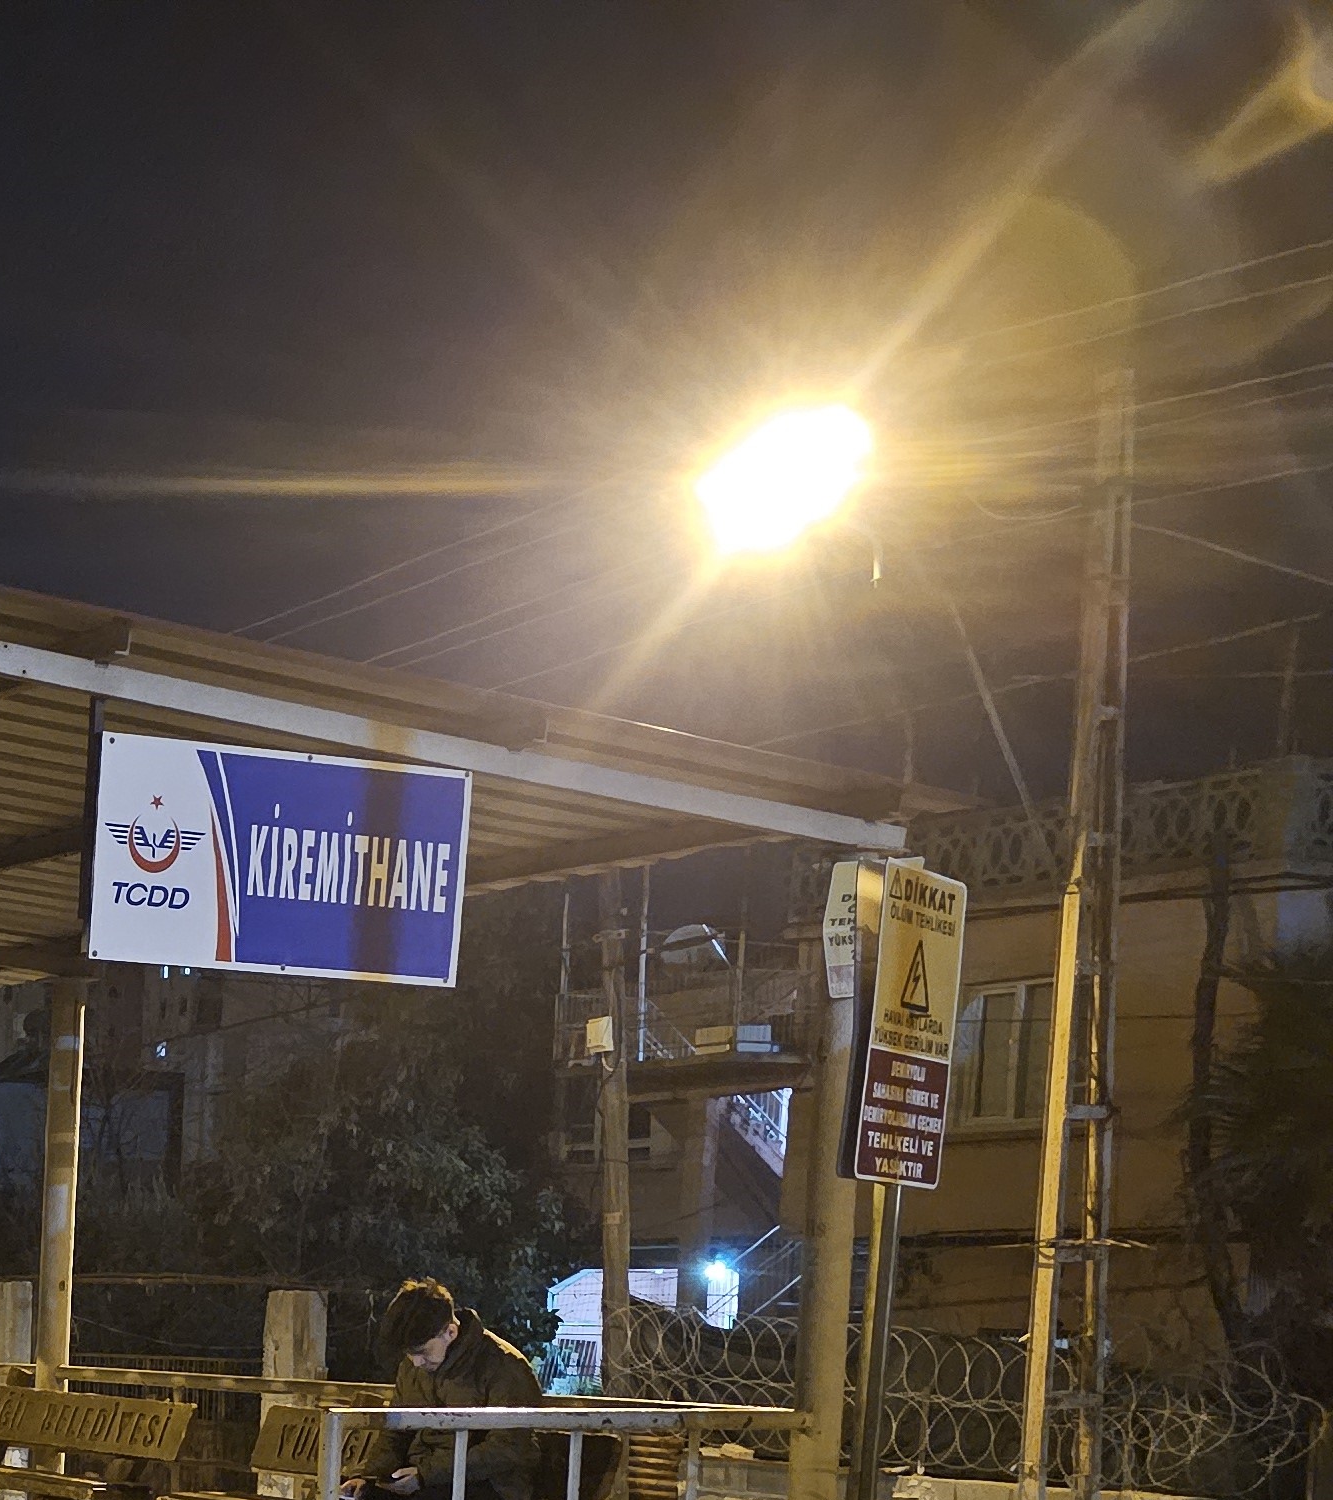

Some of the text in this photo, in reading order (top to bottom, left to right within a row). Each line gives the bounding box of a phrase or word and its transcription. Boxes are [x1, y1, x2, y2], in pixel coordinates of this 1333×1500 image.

[246, 803, 451, 914] KİREMİTHANE
[111, 881, 190, 911] TCDD
[904, 876, 956, 915] DİKKAT
[867, 1131, 935, 1157] TEHLİKELİ VE
[40, 1401, 174, 1448] BELEDİYESİ
